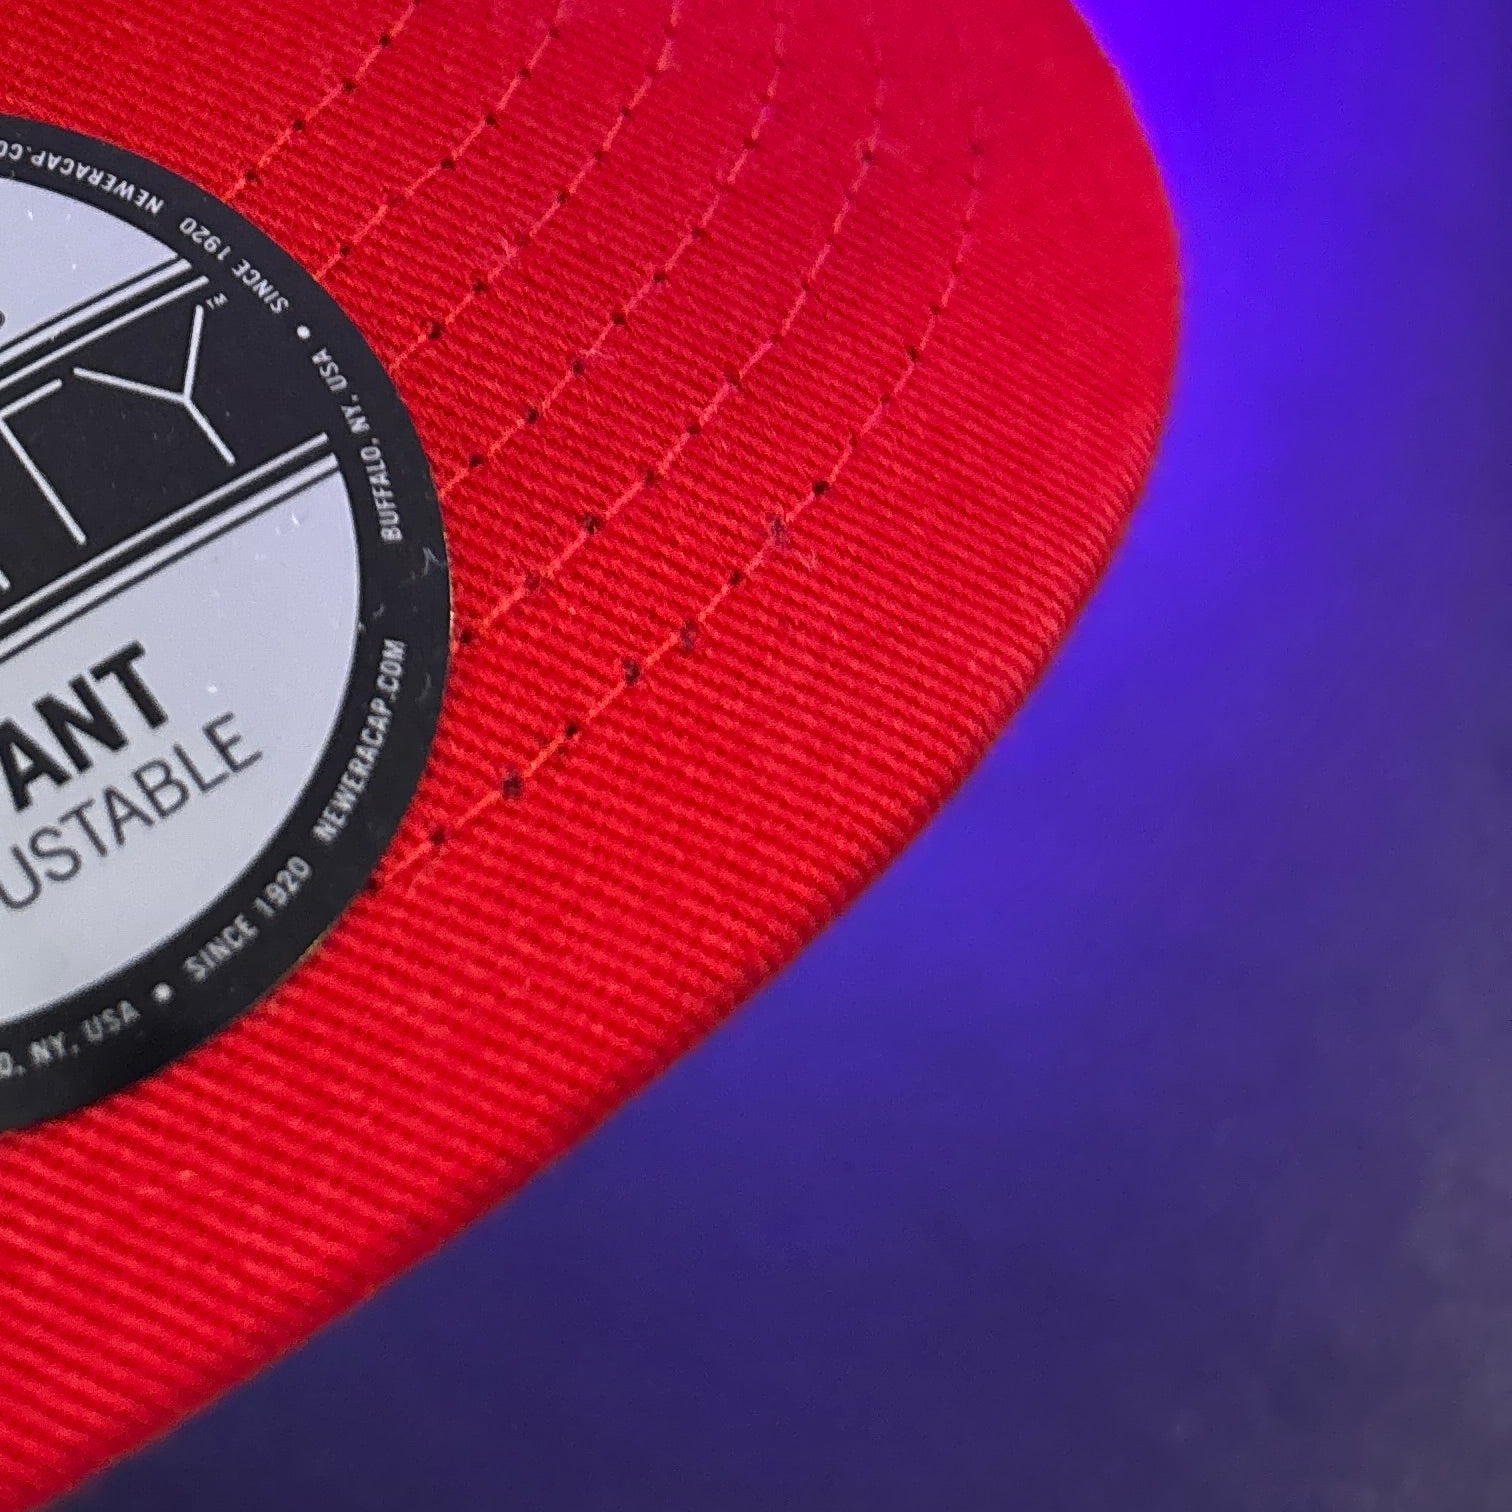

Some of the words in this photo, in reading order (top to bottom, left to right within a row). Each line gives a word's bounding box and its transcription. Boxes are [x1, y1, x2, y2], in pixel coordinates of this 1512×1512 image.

[178, 216, 231, 261] 1920
[230, 258, 289, 315] SINCE
[311, 347, 348, 392] USA
[82, 999, 141, 1044] USA
[183, 913, 259, 982] SINCE
[254, 855, 312, 918] 1920
[311, 638, 406, 845] NEWERACAP.COM
